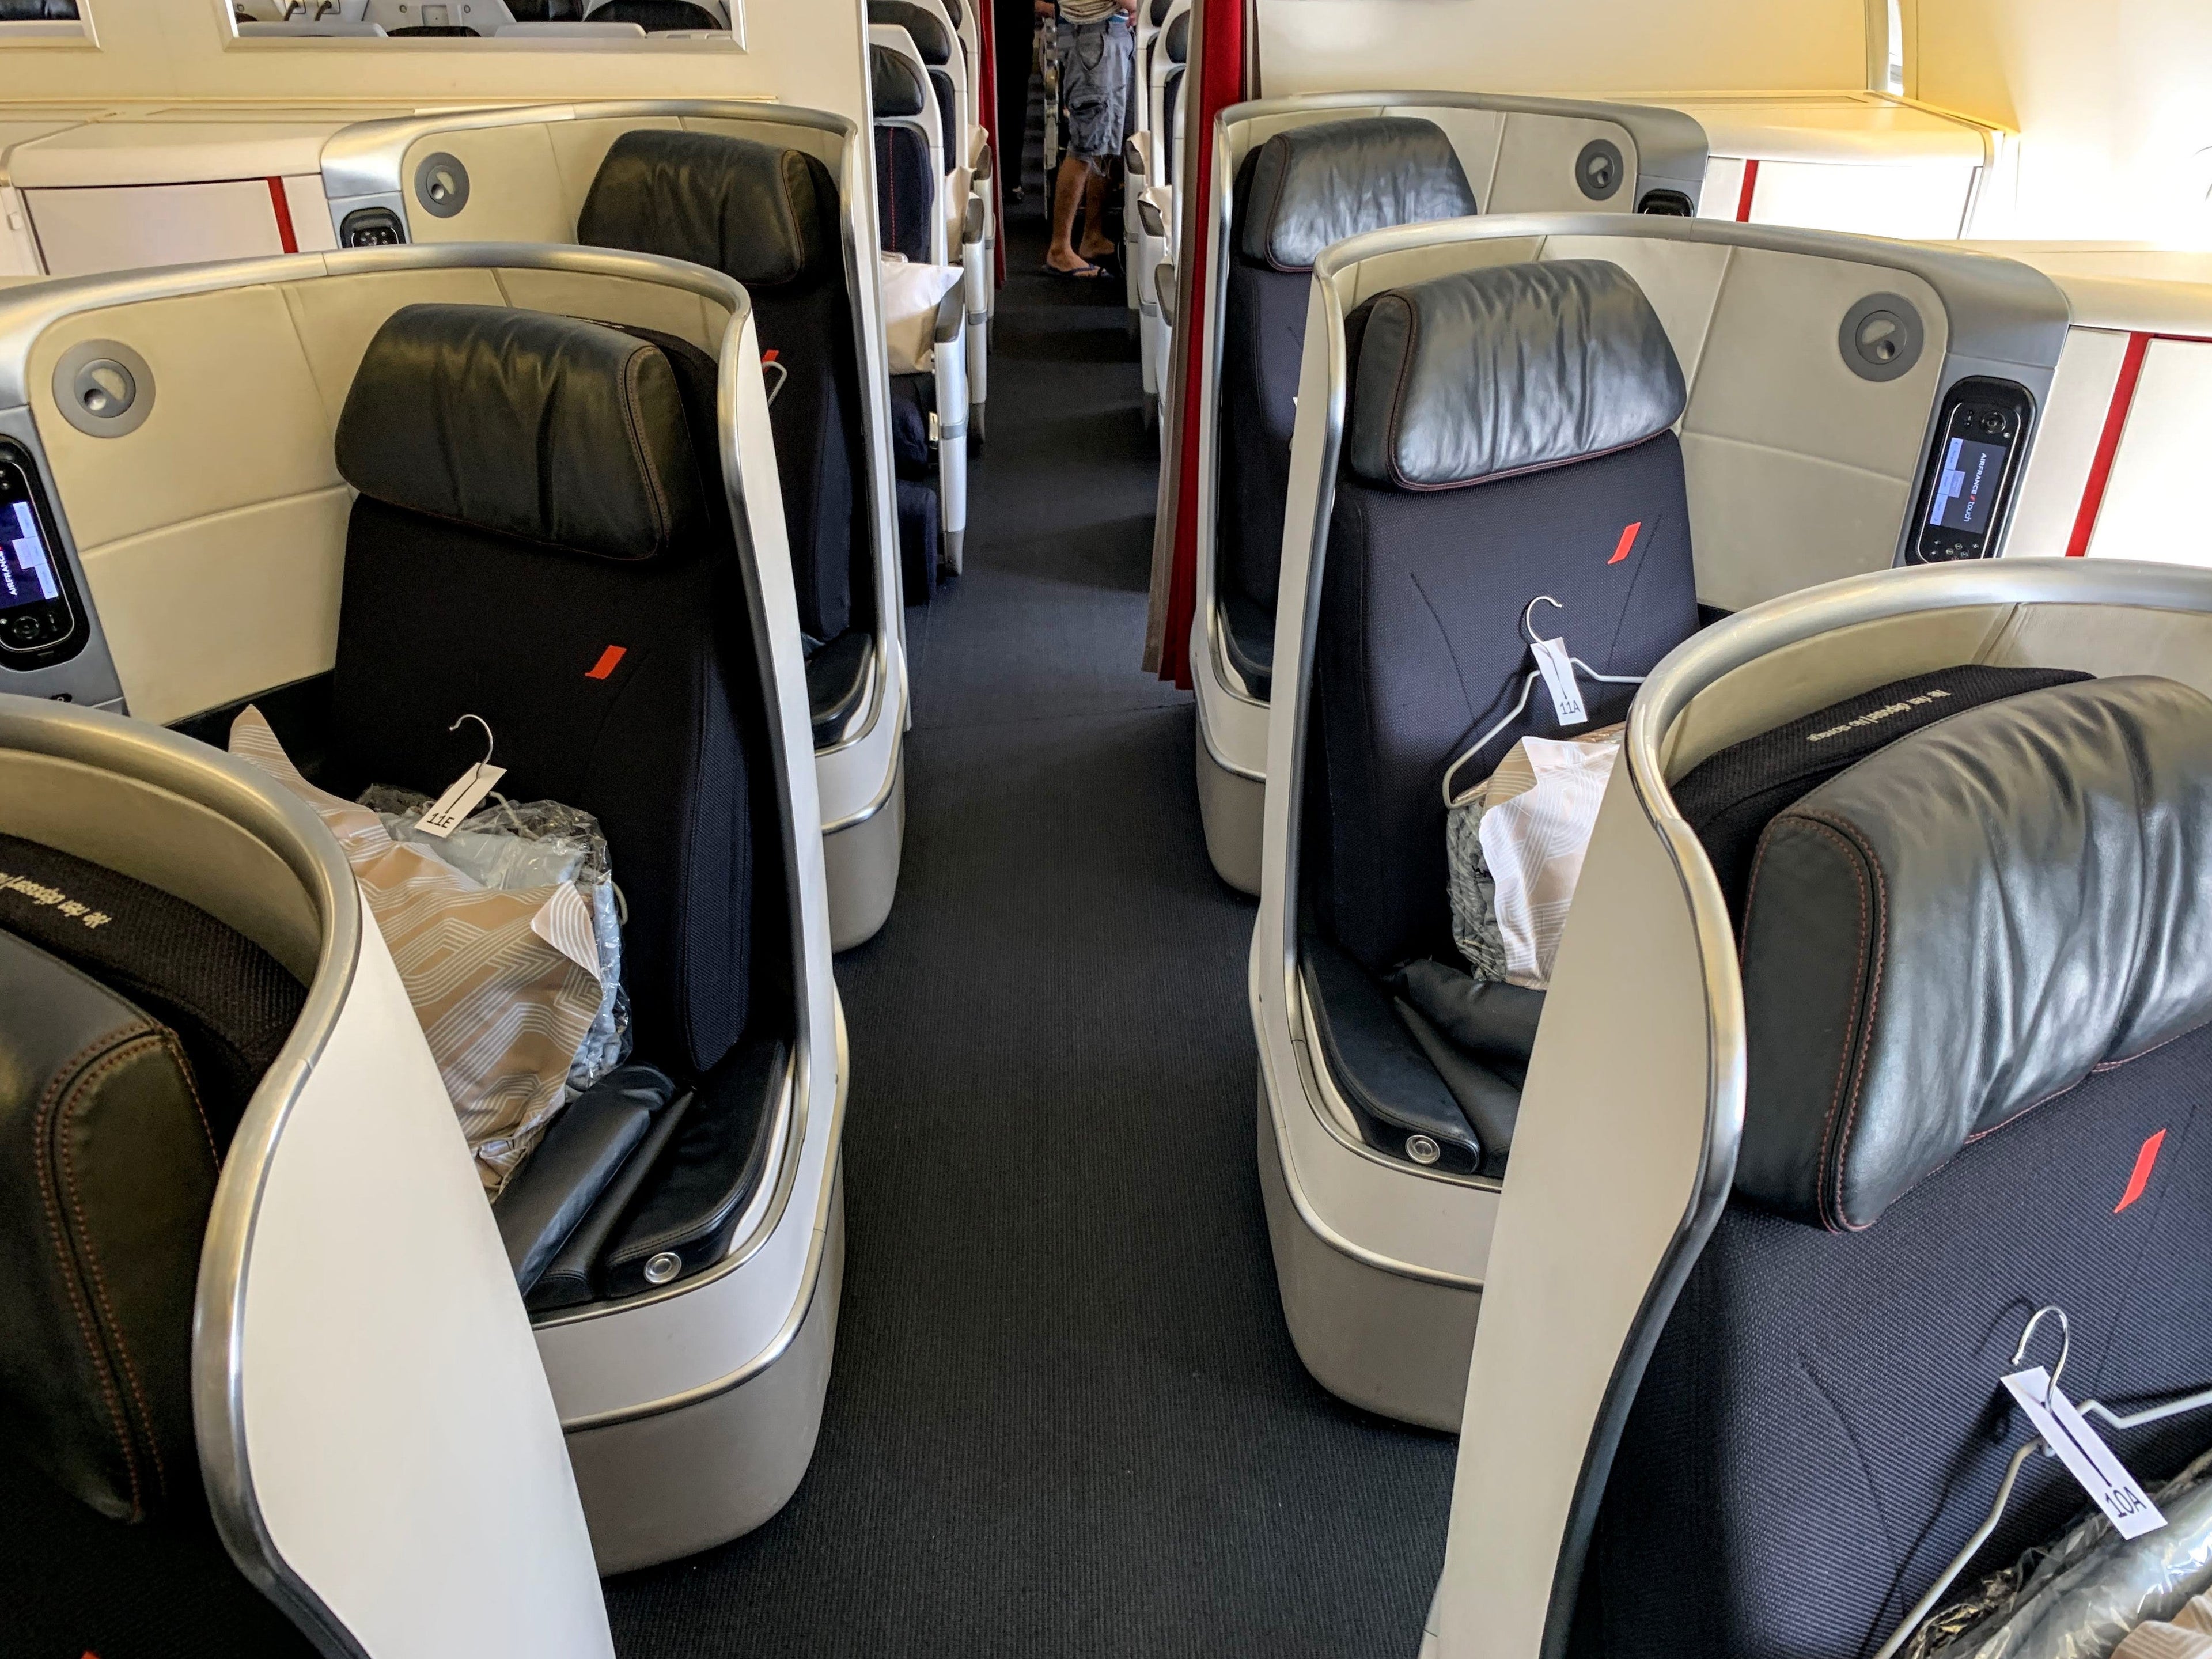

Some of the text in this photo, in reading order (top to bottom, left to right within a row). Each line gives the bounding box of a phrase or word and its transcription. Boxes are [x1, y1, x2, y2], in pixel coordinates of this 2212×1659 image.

[1964, 453, 1987, 522] AIRFRANCE touch
[1560, 700, 1581, 714] 11A
[427, 813, 454, 828] 11E
[2105, 1487, 2147, 1518] 10A
